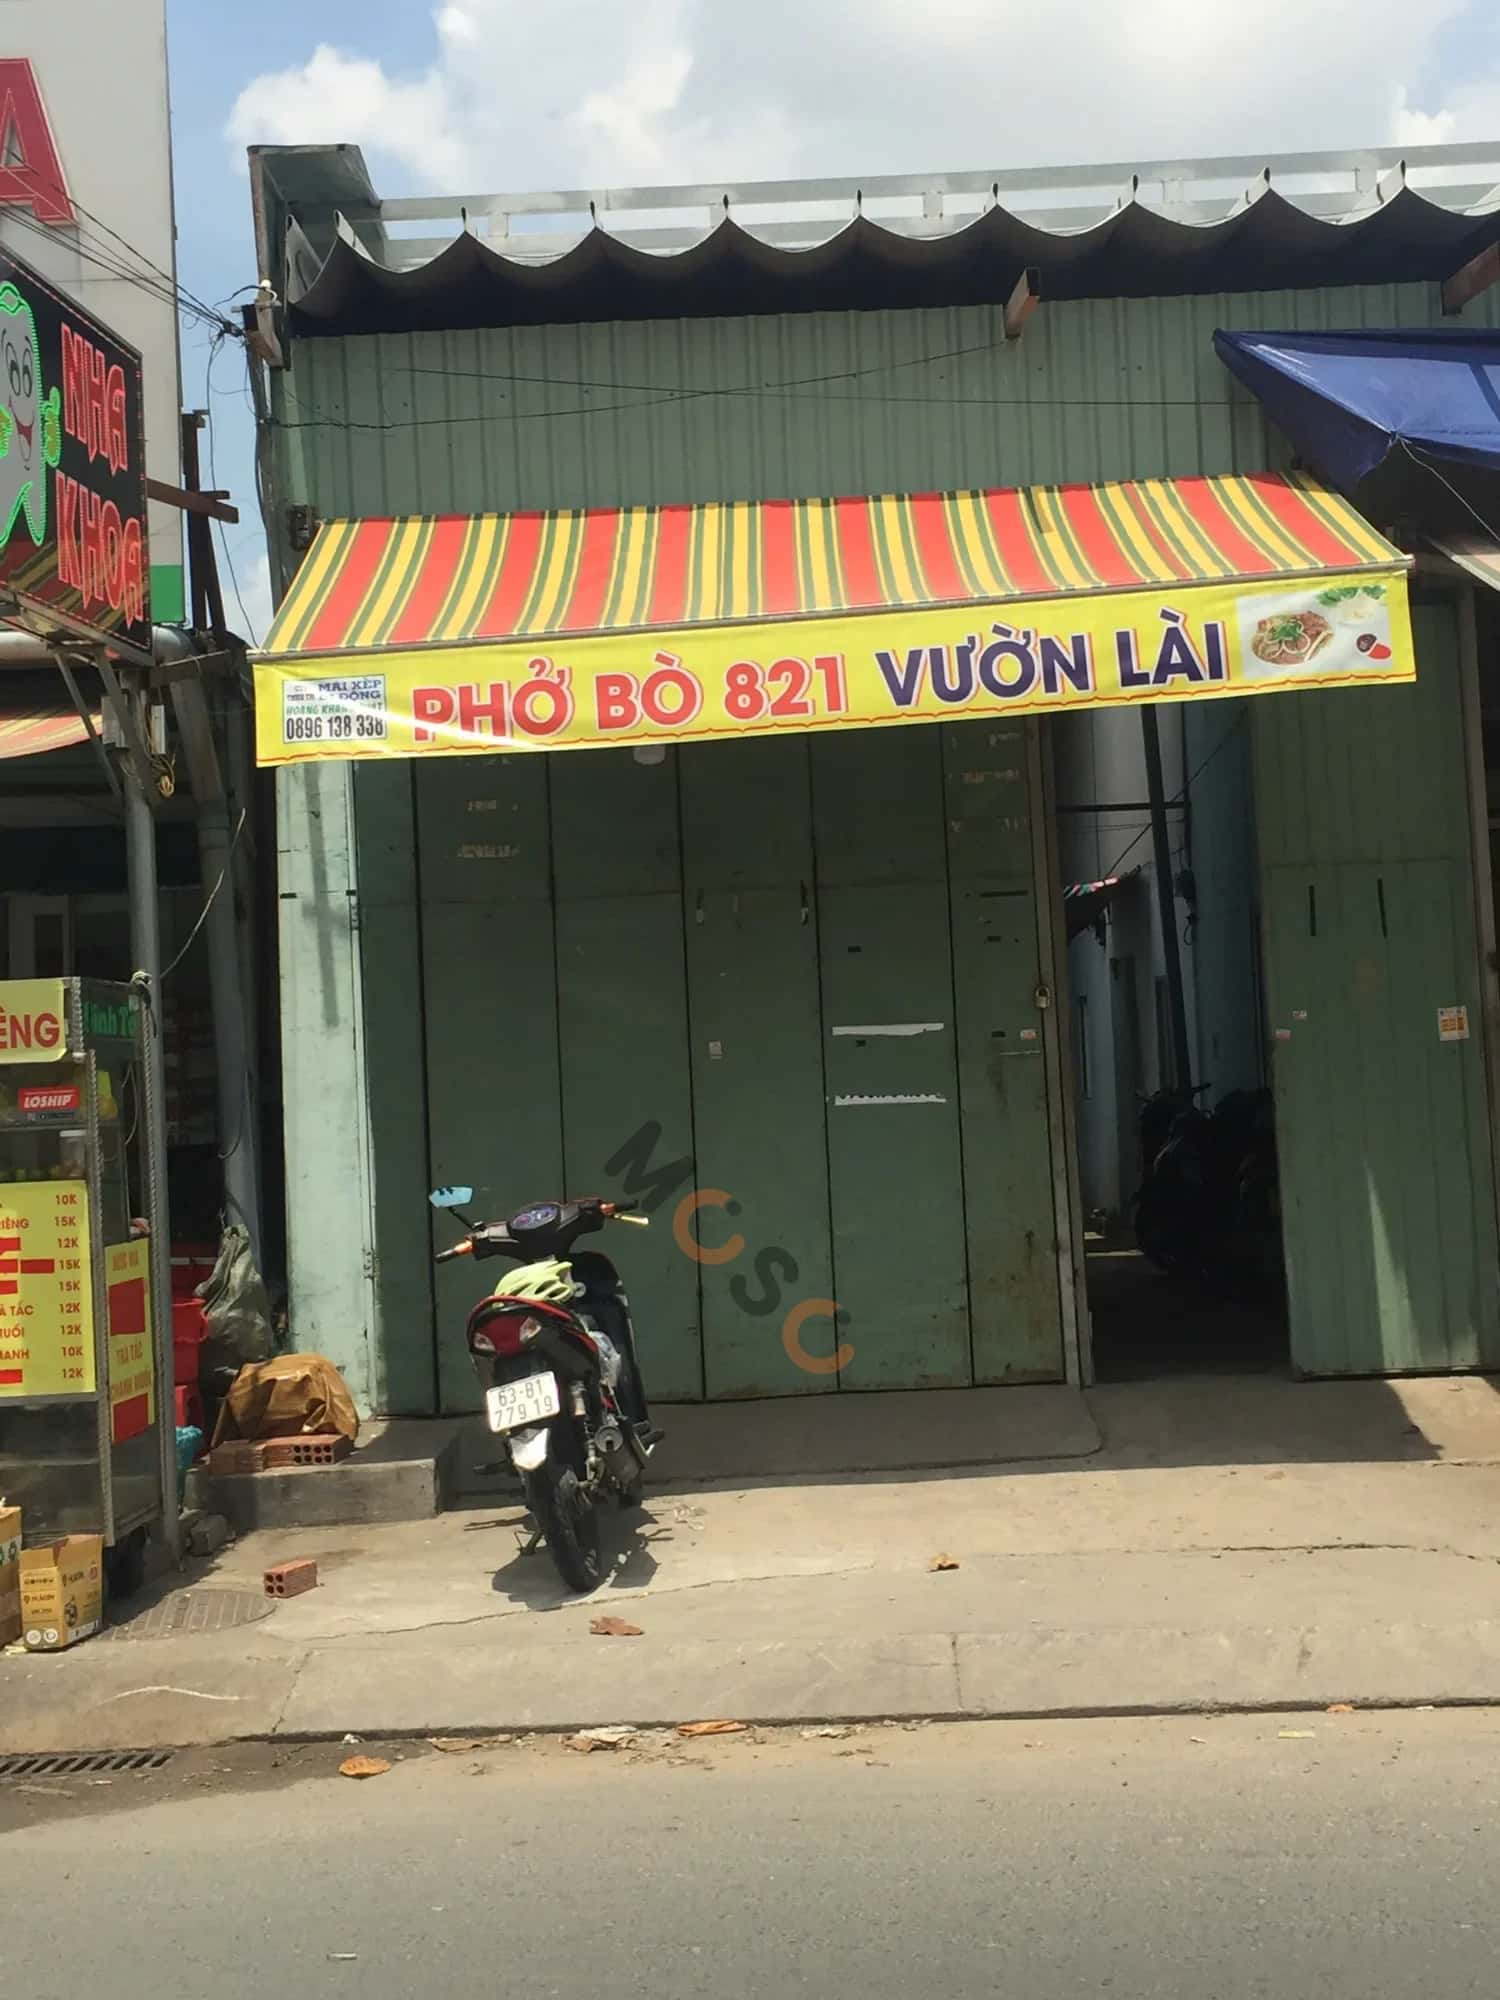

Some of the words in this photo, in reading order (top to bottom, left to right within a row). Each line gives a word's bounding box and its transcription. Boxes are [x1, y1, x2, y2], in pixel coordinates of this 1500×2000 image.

[55, 468, 144, 629] KHOA
[411, 656, 575, 743] PHỞ
[594, 650, 704, 731] BÒ
[723, 652, 849, 722] 821
[874, 622, 1096, 708] VƯỜN
[1114, 606, 1230, 689] LÀI
[286, 717, 322, 740] 0896
[326, 715, 352, 738] 138
[23, 1093, 74, 1109] LOSHIP
[55, 1194, 78, 1206] 10K
[54, 1215, 76, 1227] 15K
[57, 1237, 79, 1249] 12K
[59, 1258, 81, 1271] 15K
[58, 1280, 81, 1292] 15K
[59, 1302, 81, 1314] 12K
[60, 1324, 82, 1335] 12K
[62, 1345, 84, 1357] 10K
[62, 1367, 84, 1379] 12K
